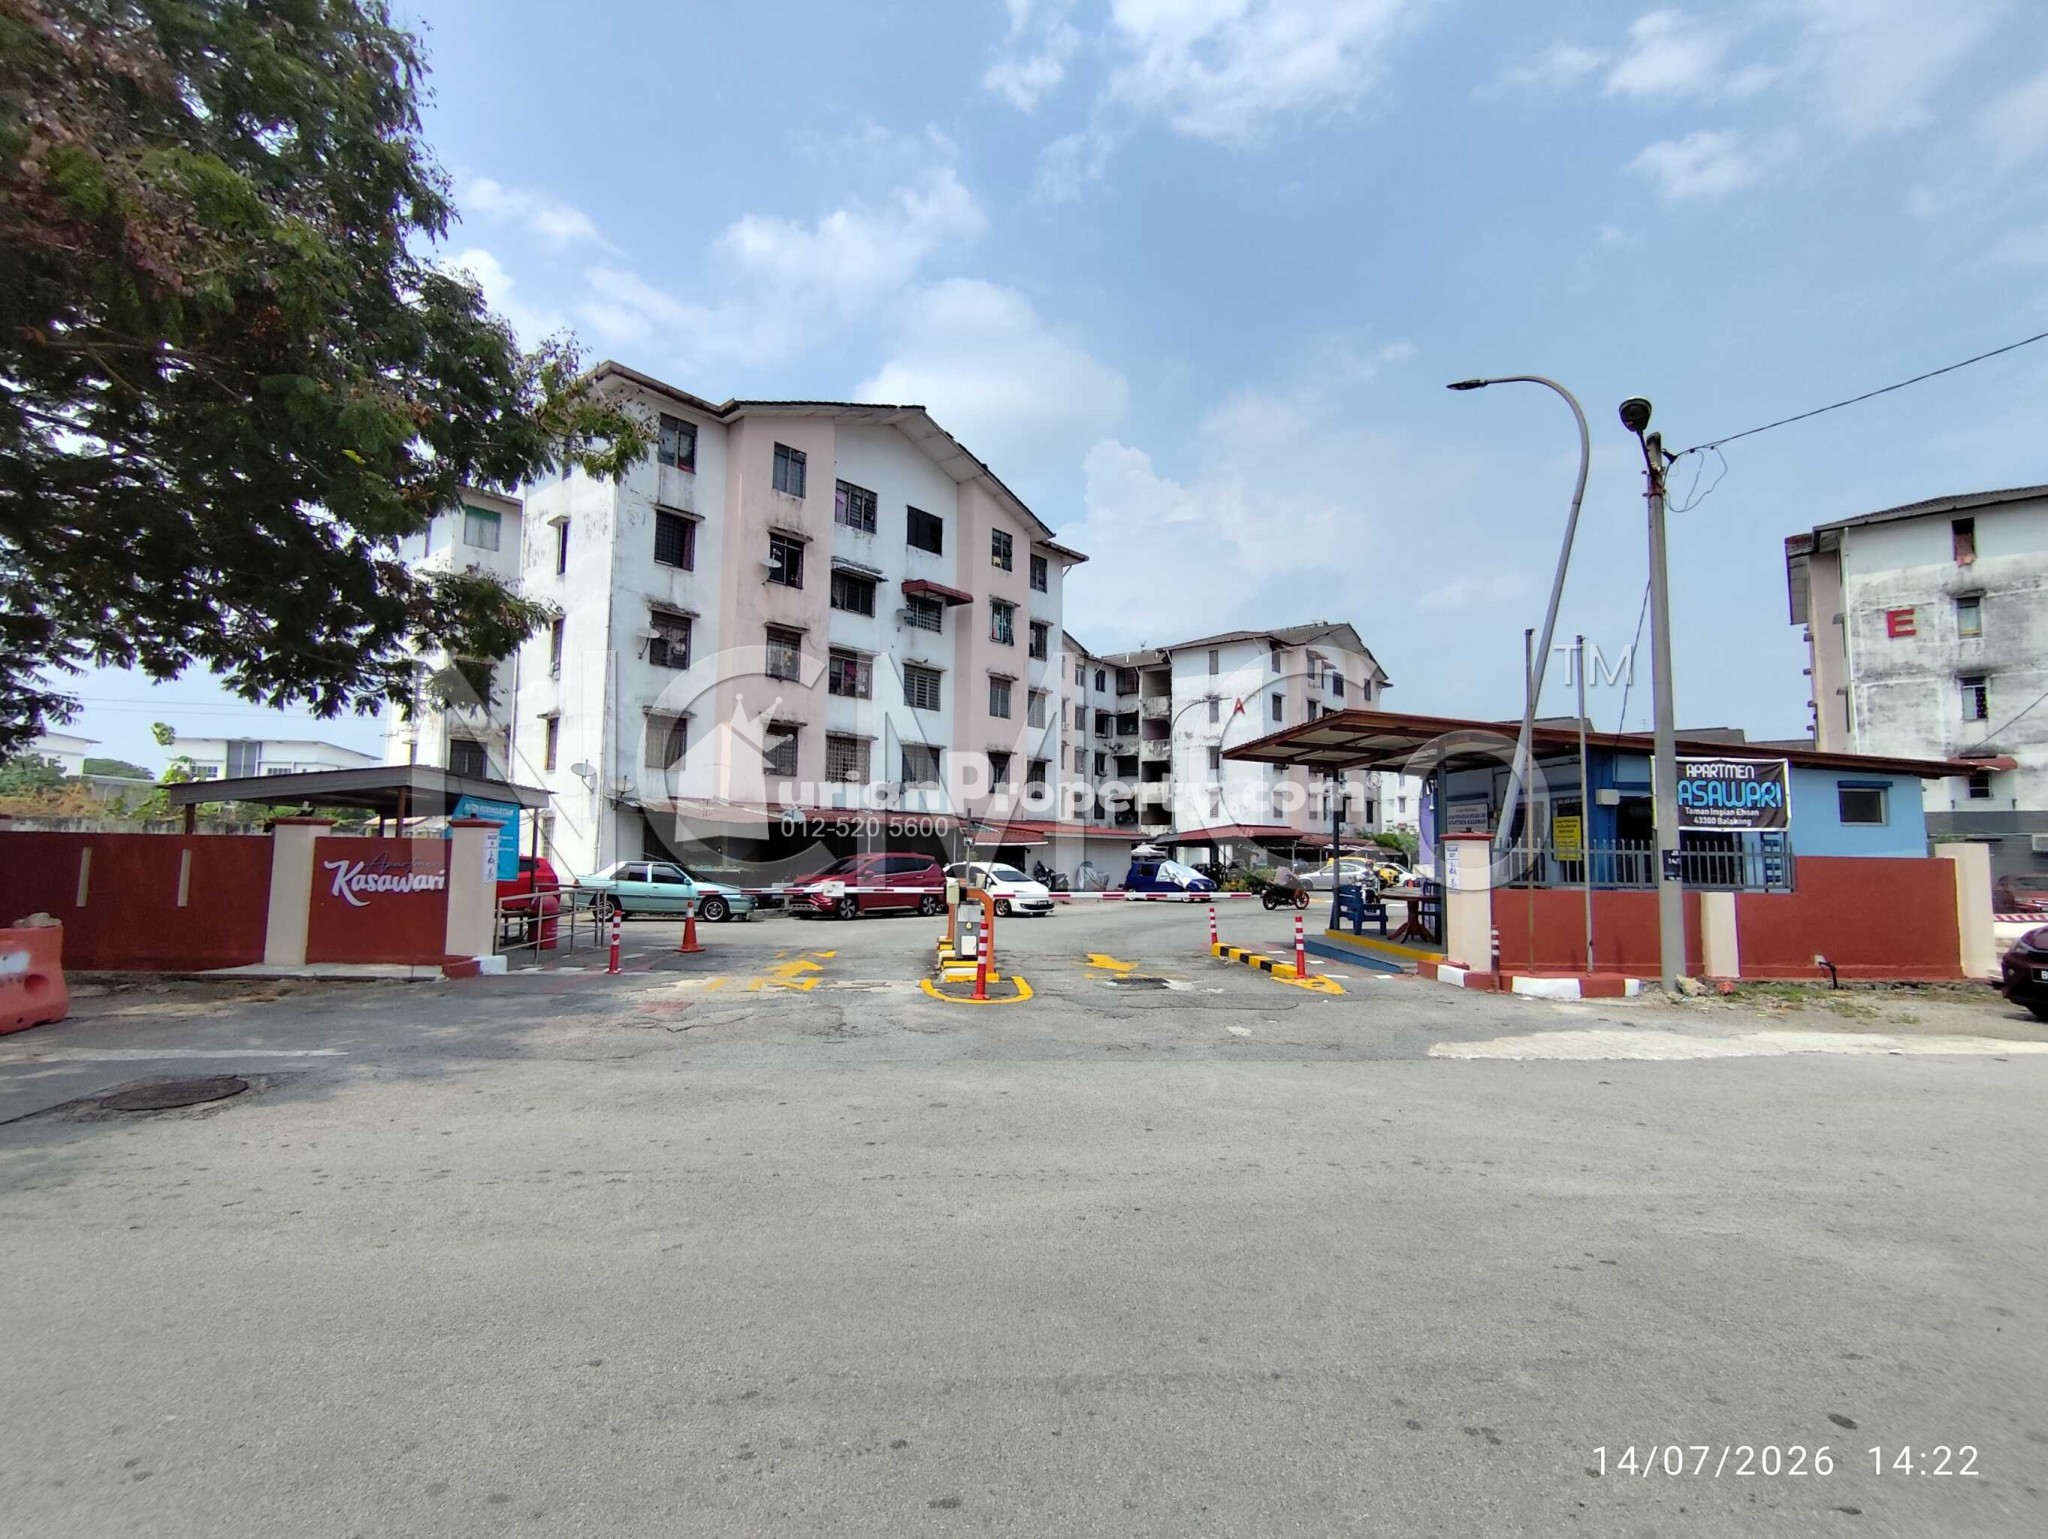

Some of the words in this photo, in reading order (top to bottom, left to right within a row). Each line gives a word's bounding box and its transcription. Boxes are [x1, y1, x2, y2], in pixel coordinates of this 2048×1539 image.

[1887, 608, 1917, 638] E
[1233, 697, 1246, 715] A
[1685, 763, 1755, 779] APARTMEN
[1677, 780, 1782, 808] ASAWARI
[1685, 807, 1710, 816] Taman
[1710, 808, 1735, 817] Impian
[1735, 808, 1760, 817] Ehsan
[1693, 817, 1717, 825] 43300
[1717, 817, 1752, 827] Balakong
[323, 859, 446, 907] Kasawari
